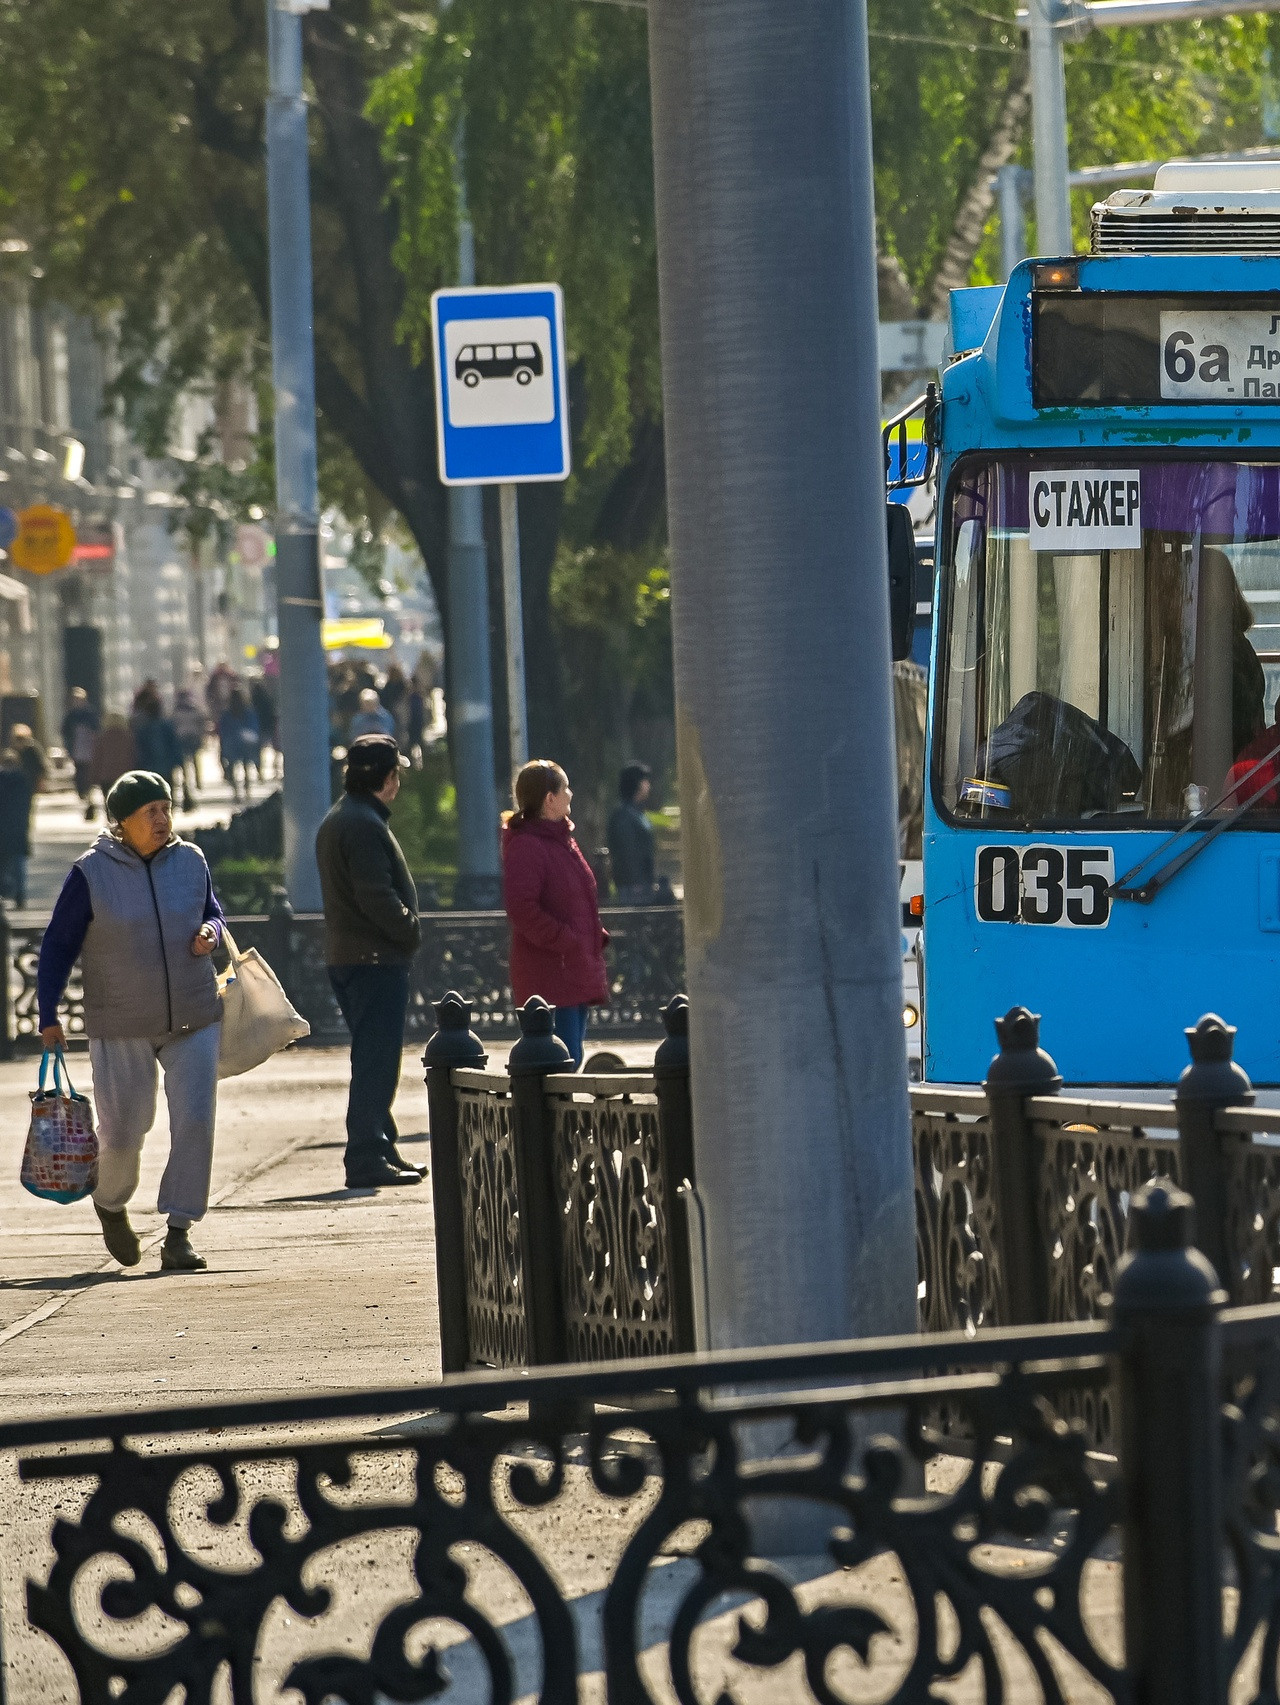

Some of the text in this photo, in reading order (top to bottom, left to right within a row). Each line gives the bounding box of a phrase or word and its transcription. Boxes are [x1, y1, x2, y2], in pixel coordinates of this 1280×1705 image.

[1164, 330, 1231, 383] 6а
[1033, 480, 1139, 527] СТАЖЕР
[978, 846, 1109, 925] 035
